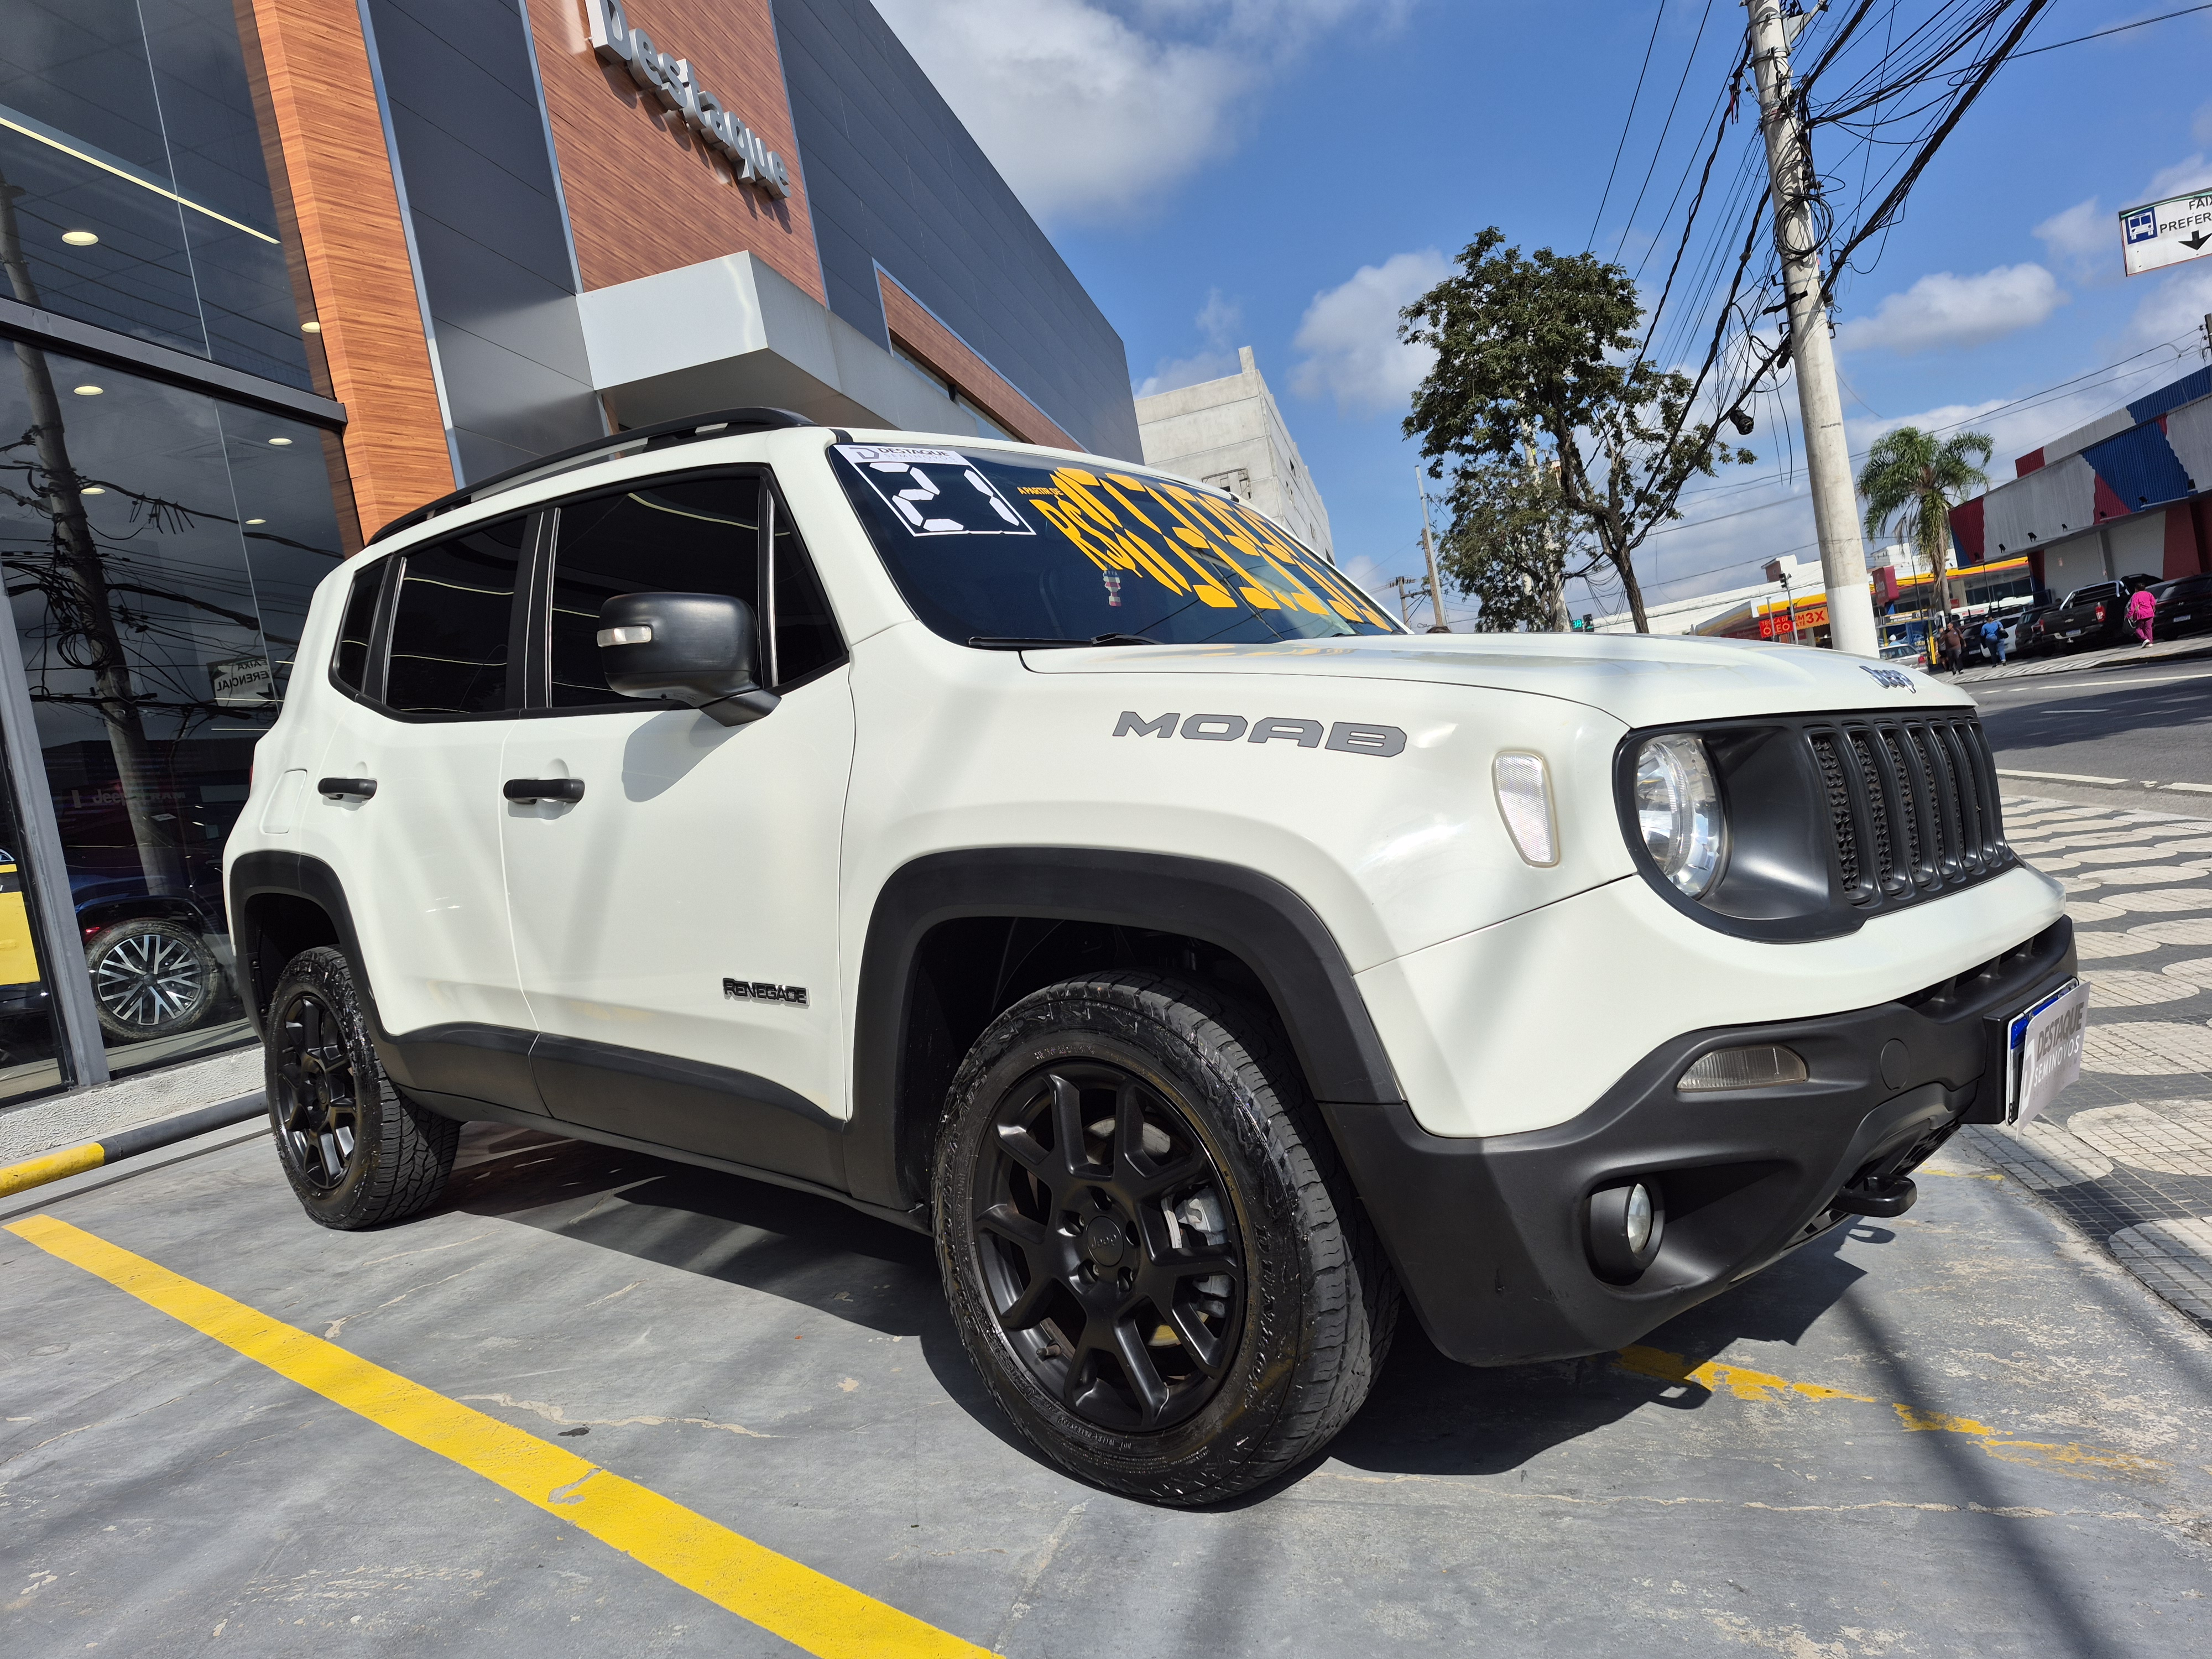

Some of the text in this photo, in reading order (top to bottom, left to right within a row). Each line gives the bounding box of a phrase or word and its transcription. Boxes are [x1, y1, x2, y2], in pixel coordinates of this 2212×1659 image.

[586, 0, 791, 200] Destaque
[2159, 212, 2212, 234] PREFER
[877, 447, 950, 457] DESTAQUE
[869, 462, 1020, 532] 21
[1022, 487, 1053, 495] PARTIR
[1048, 488, 1065, 496] DE
[1029, 494, 1143, 578] R$
[1763, 622, 1791, 635] ÓEO
[1806, 609, 1825, 624] 3X
[1112, 711, 1407, 758] MOAB
[722, 977, 810, 1008] RENEGADE
[2036, 1001, 2084, 1062] DESTAQUE
[2033, 1034, 2080, 1088] SEMINOVOS
[1243, 1221, 1276, 1410] DUNLOP
